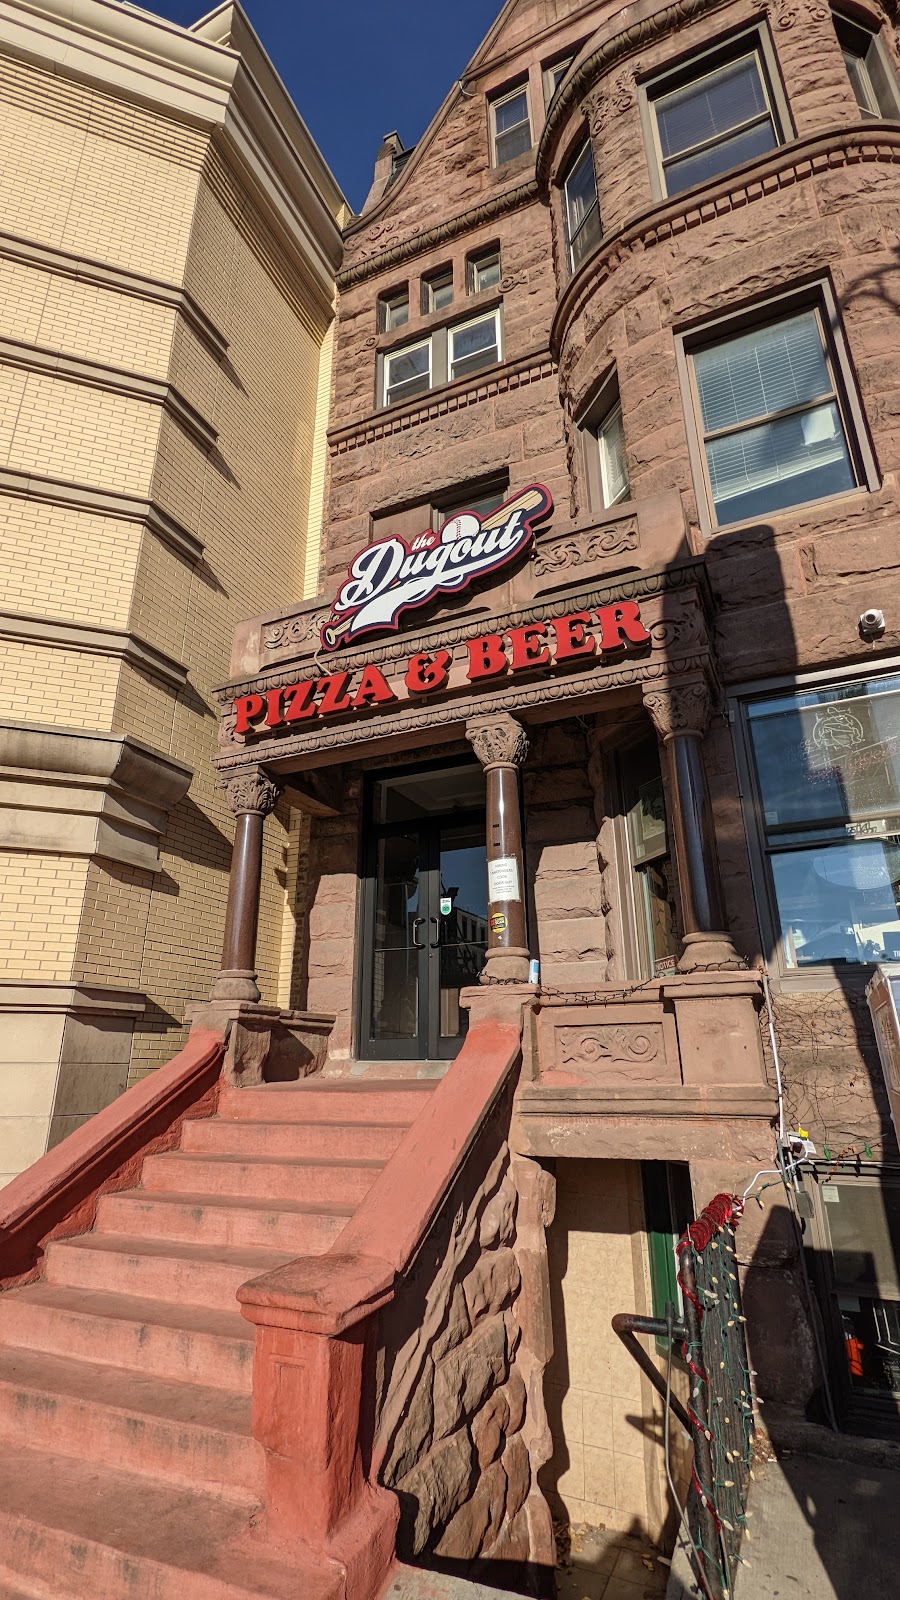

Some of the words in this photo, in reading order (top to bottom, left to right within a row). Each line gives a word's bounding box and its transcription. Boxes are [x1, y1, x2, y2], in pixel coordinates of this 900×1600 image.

[334, 508, 525, 611] Dugout
[412, 533, 436, 552] the
[233, 664, 395, 734] PIZZA
[404, 650, 452, 693] &
[465, 601, 651, 680] BEER
[655, 959, 675, 970] NOTICE
